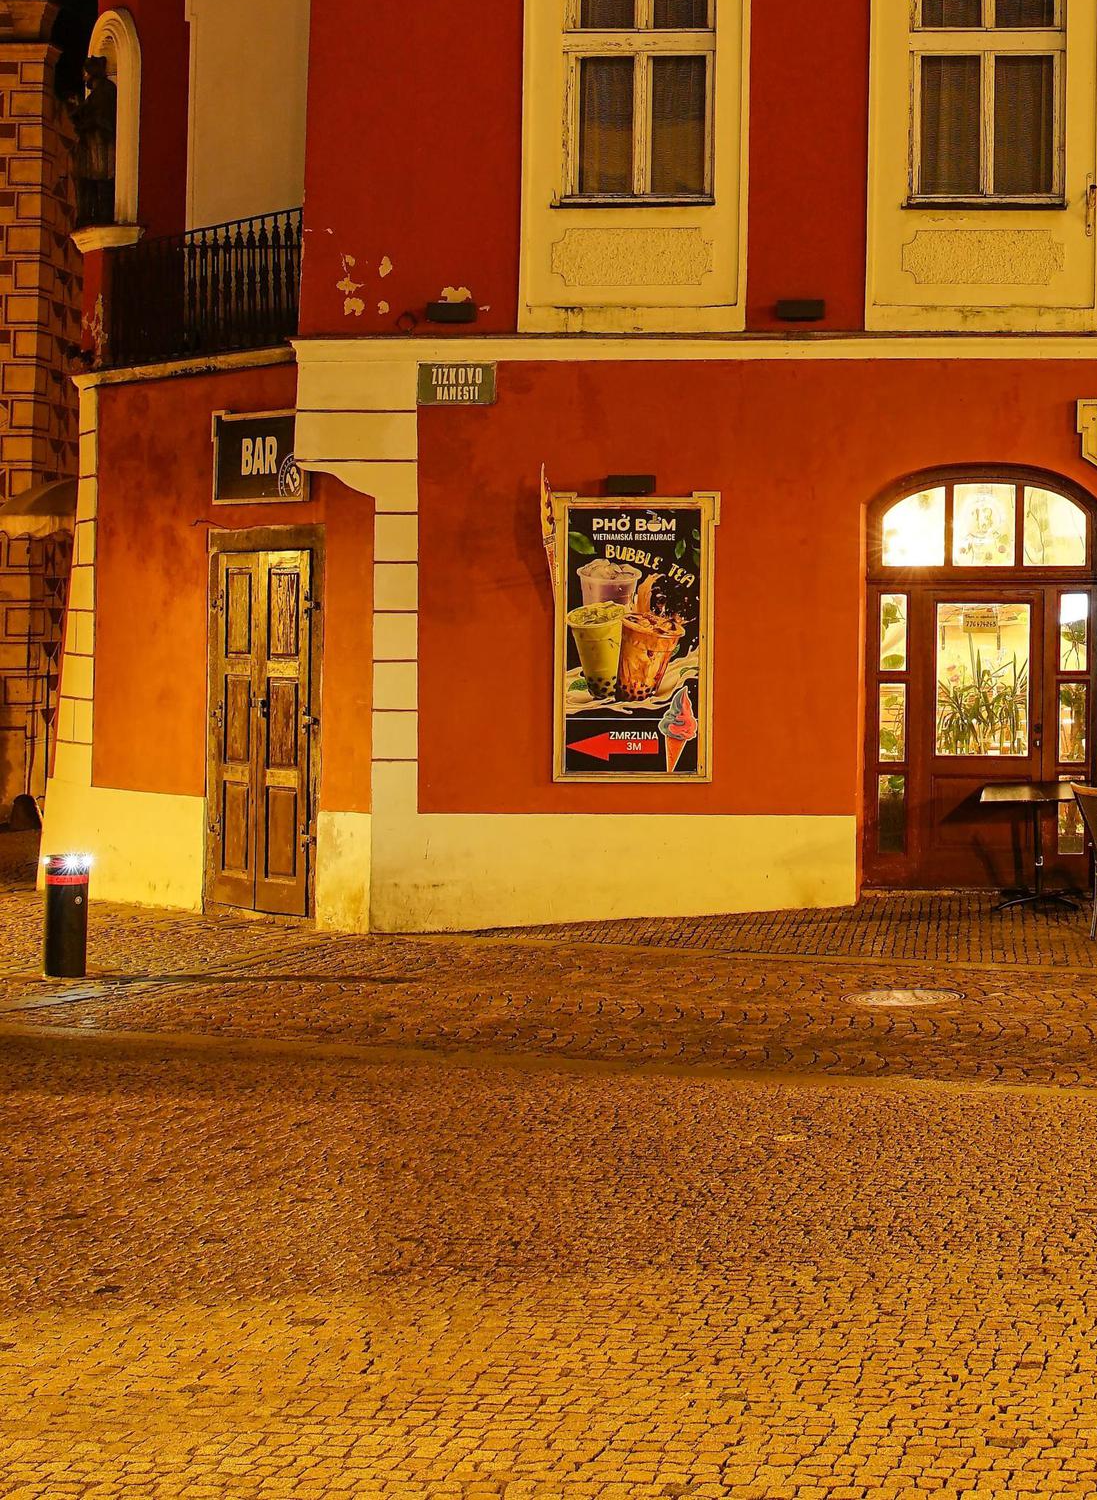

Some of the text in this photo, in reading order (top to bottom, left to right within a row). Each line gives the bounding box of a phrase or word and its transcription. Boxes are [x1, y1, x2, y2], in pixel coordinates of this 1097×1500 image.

[241, 436, 278, 476] BAR
[592, 532, 676, 541] VIETNAMSKÁ RESTAURACE
[605, 544, 696, 588] BUBBLE TEA
[609, 731, 659, 740] ZMRZLINA
[626, 741, 642, 751] 3M
